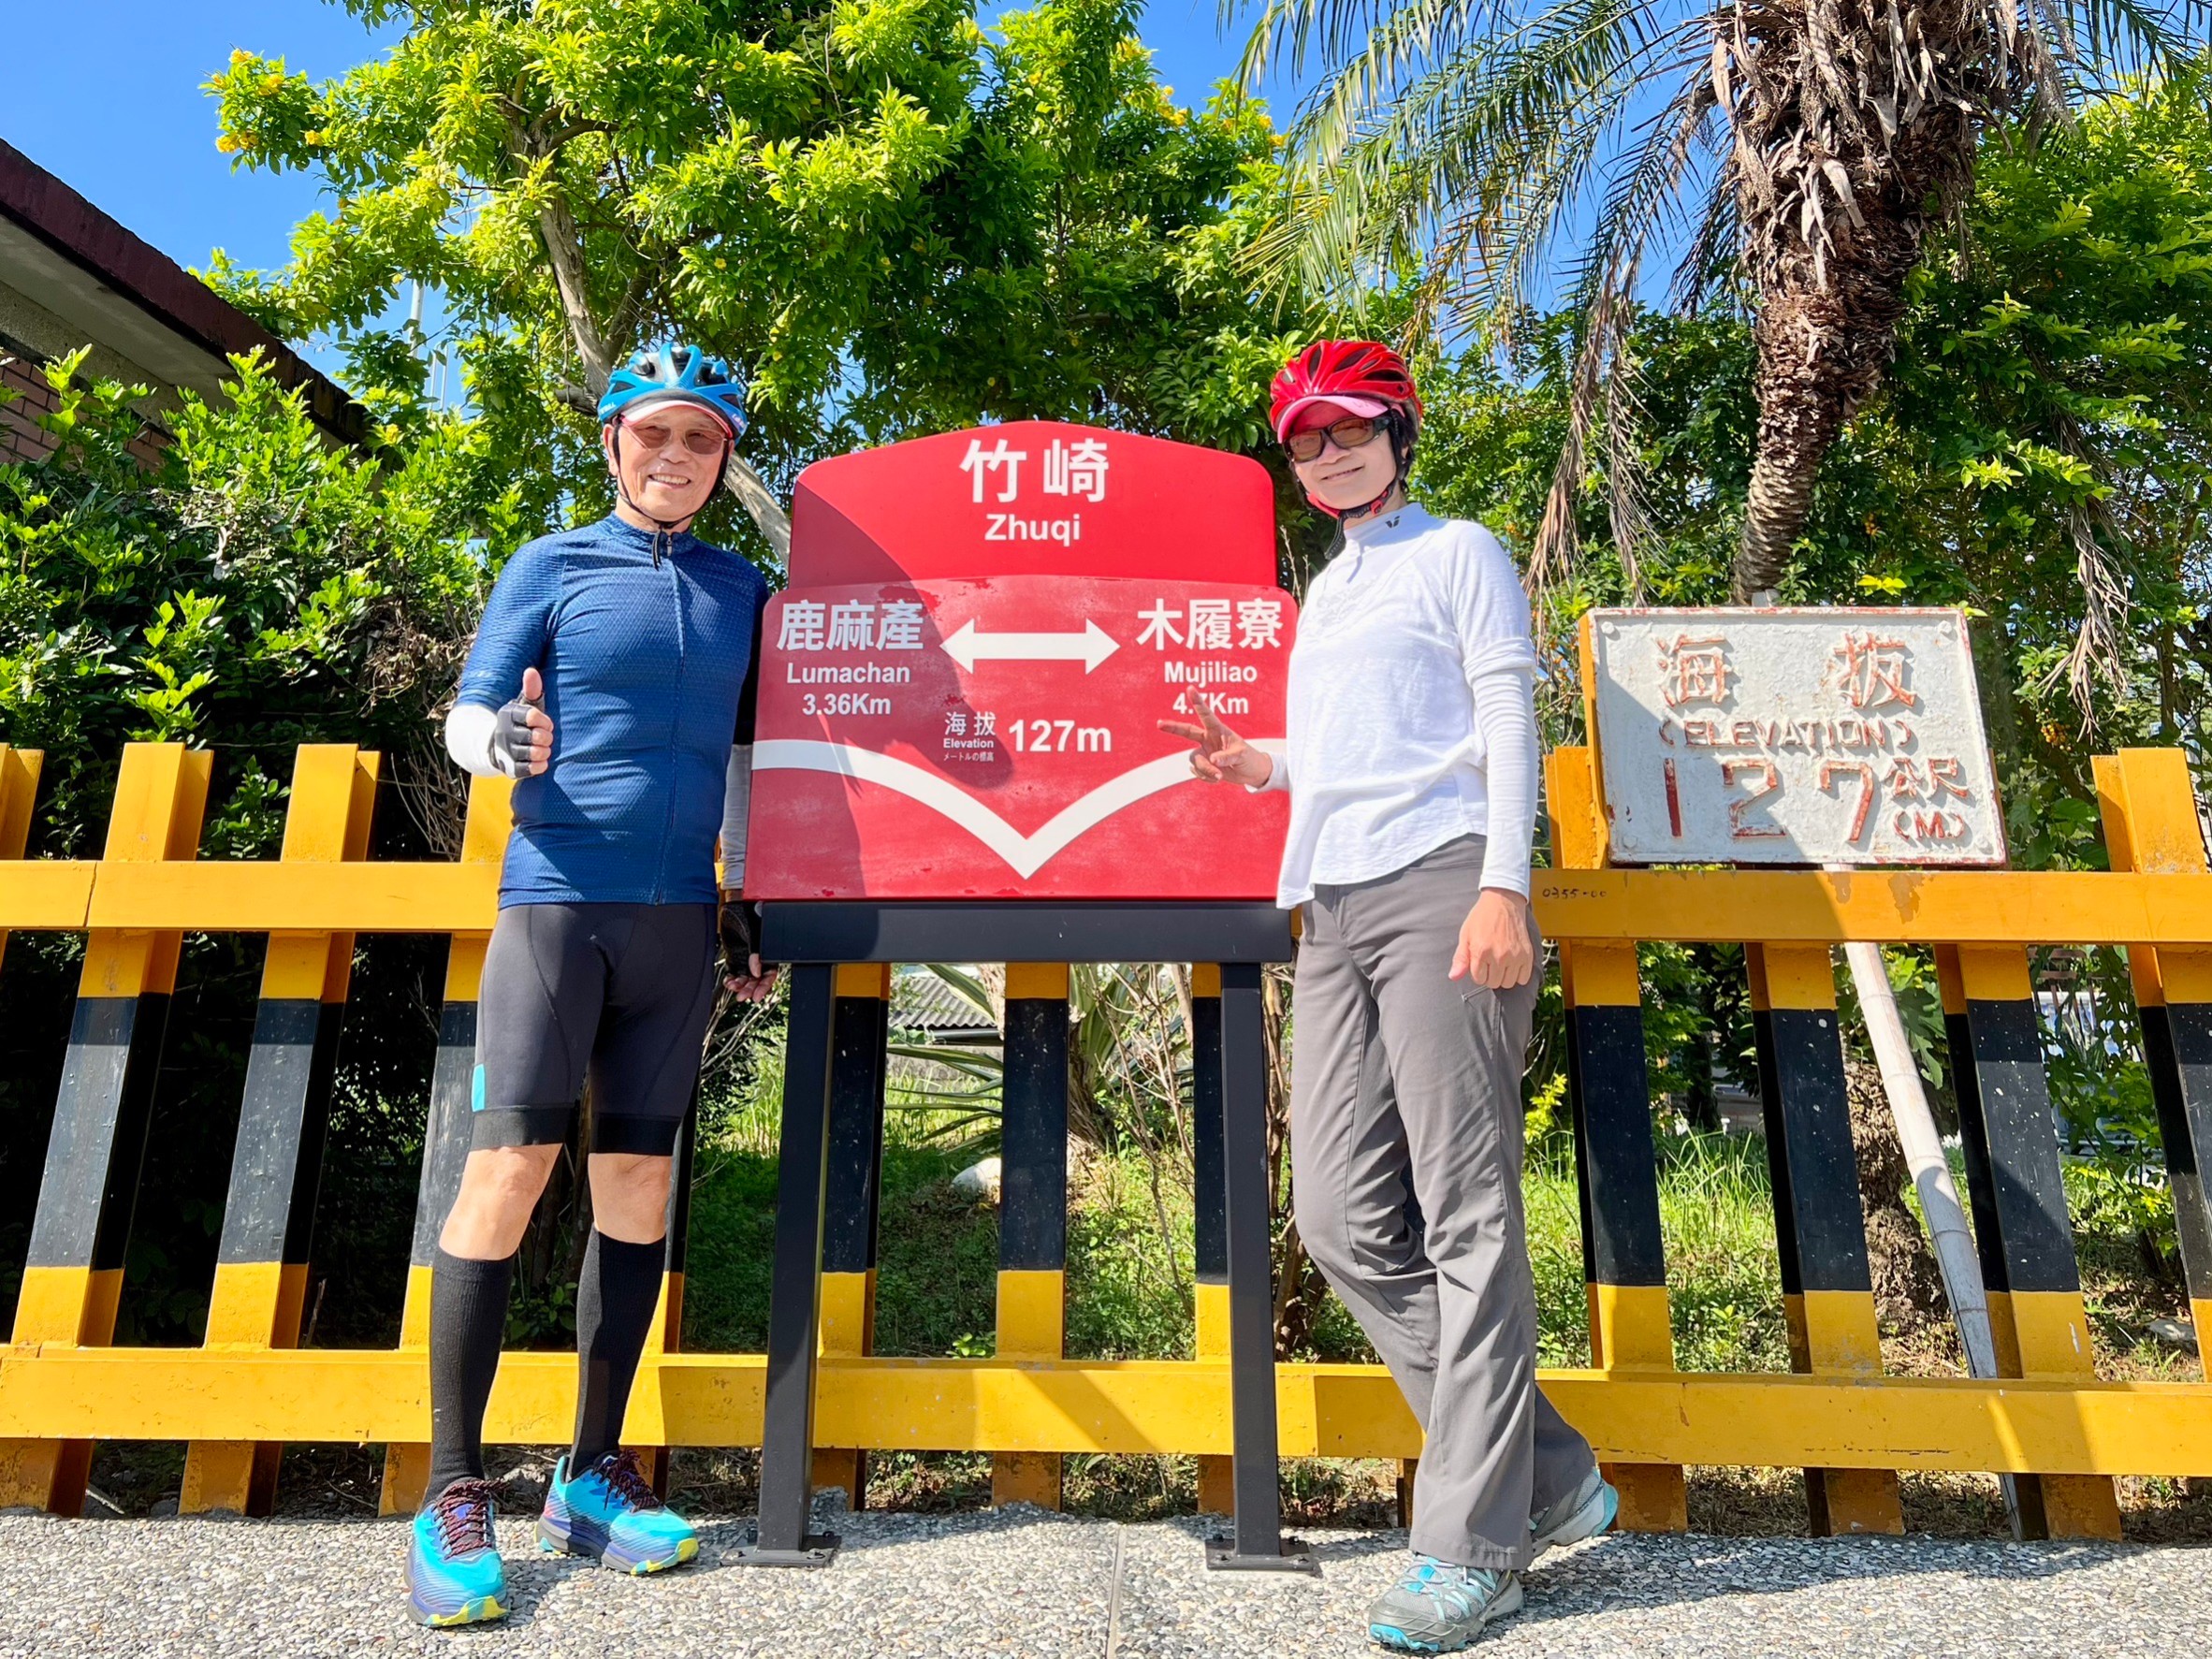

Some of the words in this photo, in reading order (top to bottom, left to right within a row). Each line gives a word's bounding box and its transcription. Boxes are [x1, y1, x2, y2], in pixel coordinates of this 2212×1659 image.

[959, 438, 1109, 503] 竹崎
[984, 513, 1081, 547] Zhuqi
[777, 599, 924, 651] 鹿麻產
[1136, 598, 1283, 651] 木履寮
[787, 662, 910, 684] Lumachan
[1164, 661, 1259, 689] Mujiliao
[802, 692, 892, 716] 3.36Km
[944, 711, 996, 736] 海拔
[1009, 719, 1112, 752] 127m
[943, 737, 995, 749] Elevation
[1662, 756, 1874, 841] 127
